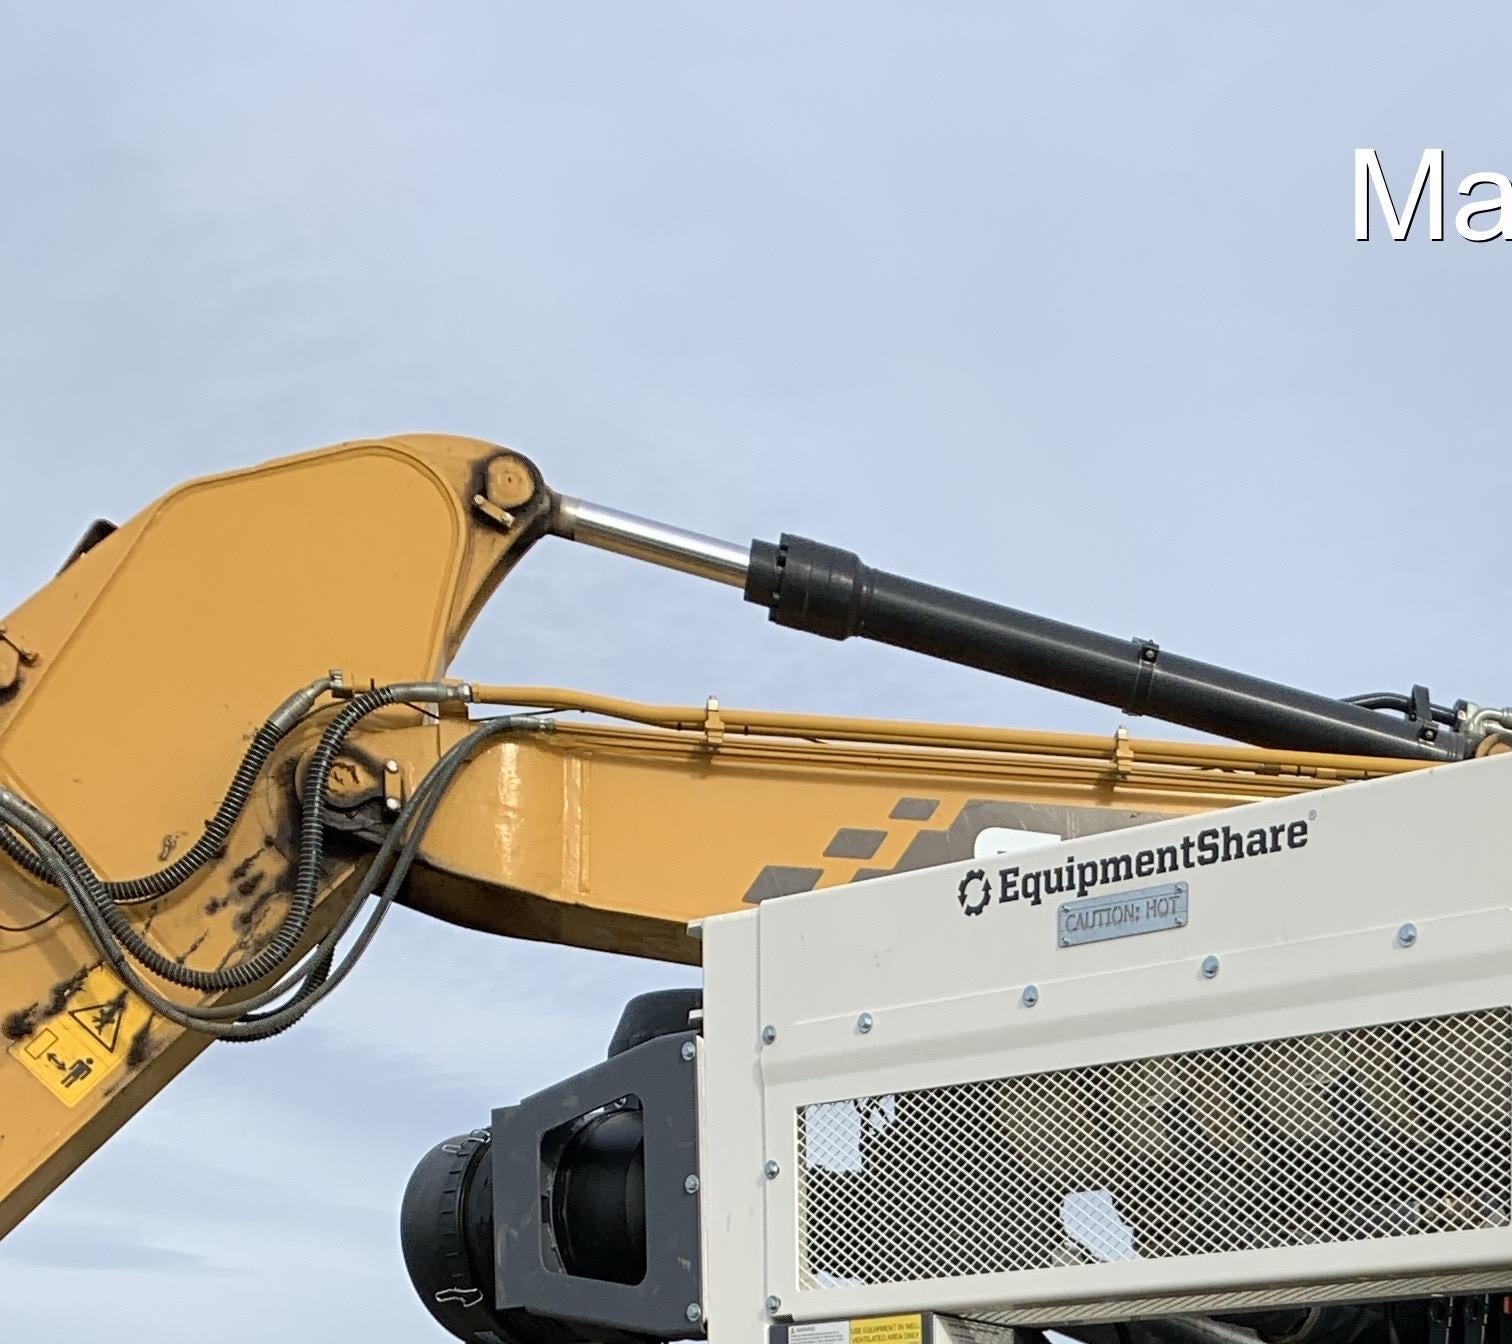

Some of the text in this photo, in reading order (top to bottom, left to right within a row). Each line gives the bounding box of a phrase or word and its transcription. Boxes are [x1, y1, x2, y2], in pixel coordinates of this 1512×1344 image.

[998, 818, 1309, 907] EquipmentShare
[1065, 896, 1180, 934] CAUTION: HOT
